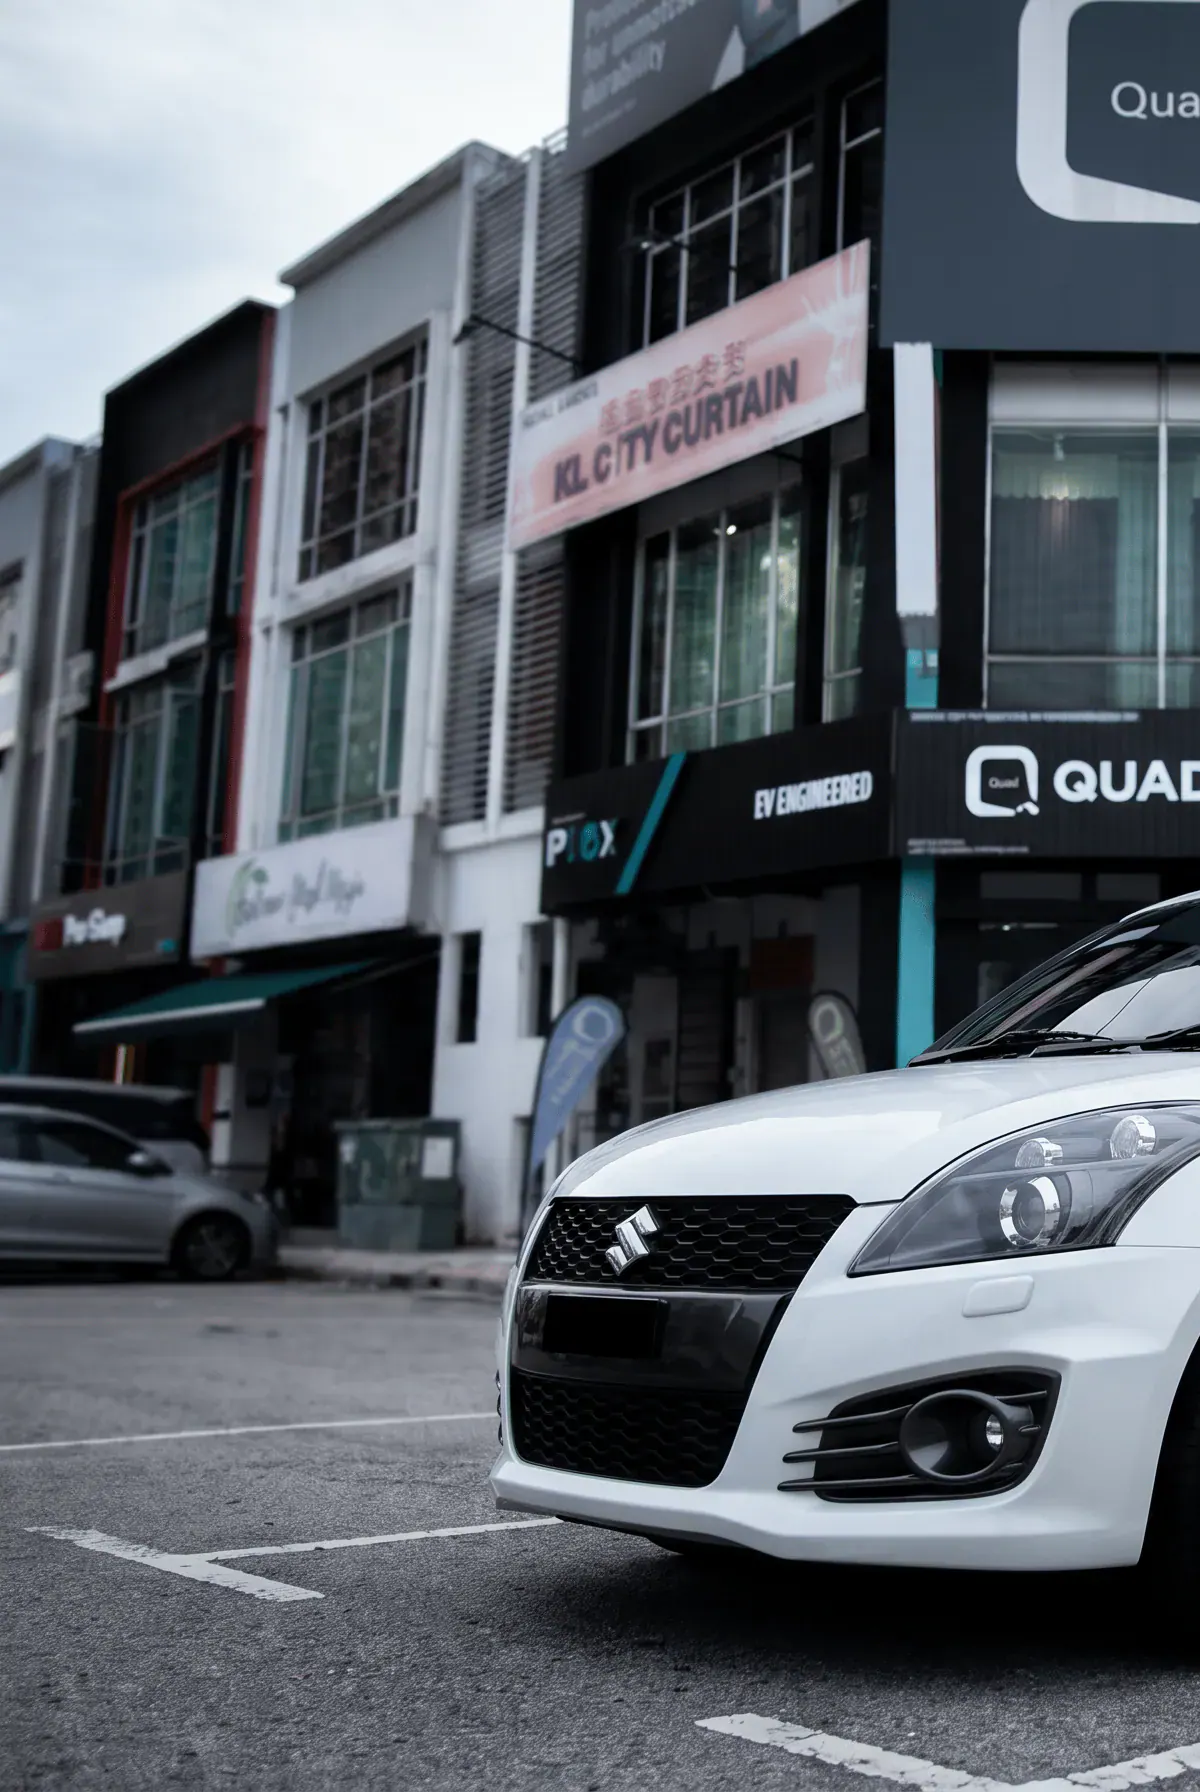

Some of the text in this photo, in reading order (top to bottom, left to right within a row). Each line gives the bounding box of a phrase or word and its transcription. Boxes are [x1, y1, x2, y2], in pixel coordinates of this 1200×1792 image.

[553, 453, 589, 502] KL
[593, 420, 660, 487] CITY
[662, 357, 799, 456] CURTAIN
[754, 770, 873, 820] EV ENGINEERED
[988, 776, 1020, 789] Quad
